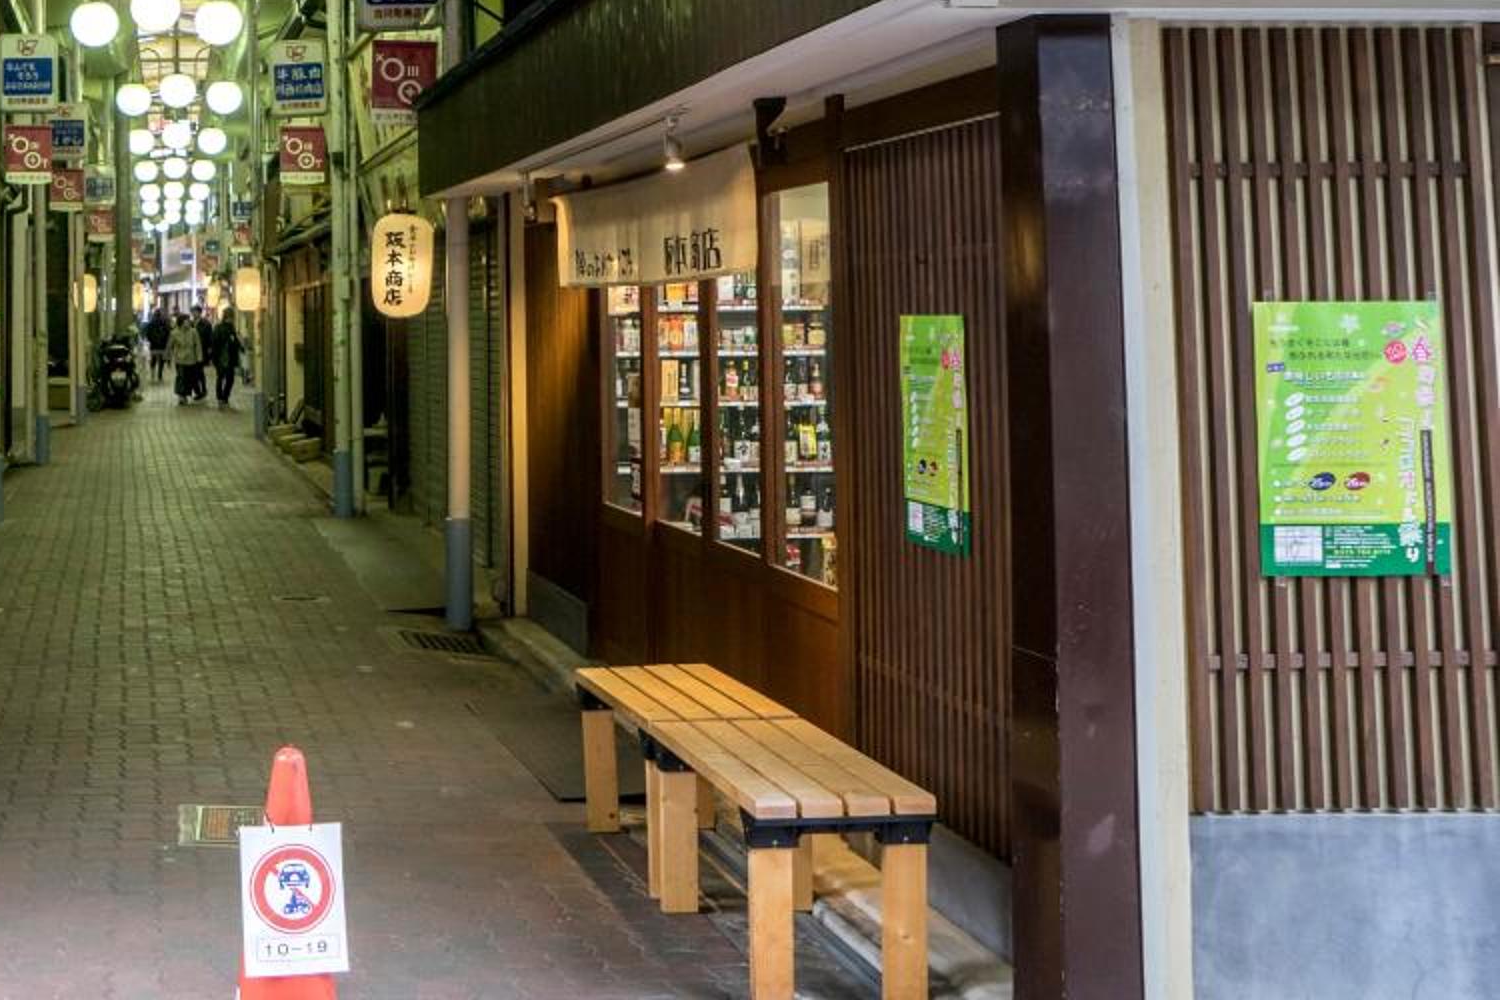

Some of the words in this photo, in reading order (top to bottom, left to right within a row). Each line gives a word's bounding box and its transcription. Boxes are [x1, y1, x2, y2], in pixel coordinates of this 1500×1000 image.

[383, 231, 406, 307] 阪本商店
[264, 939, 328, 958] 10-19
